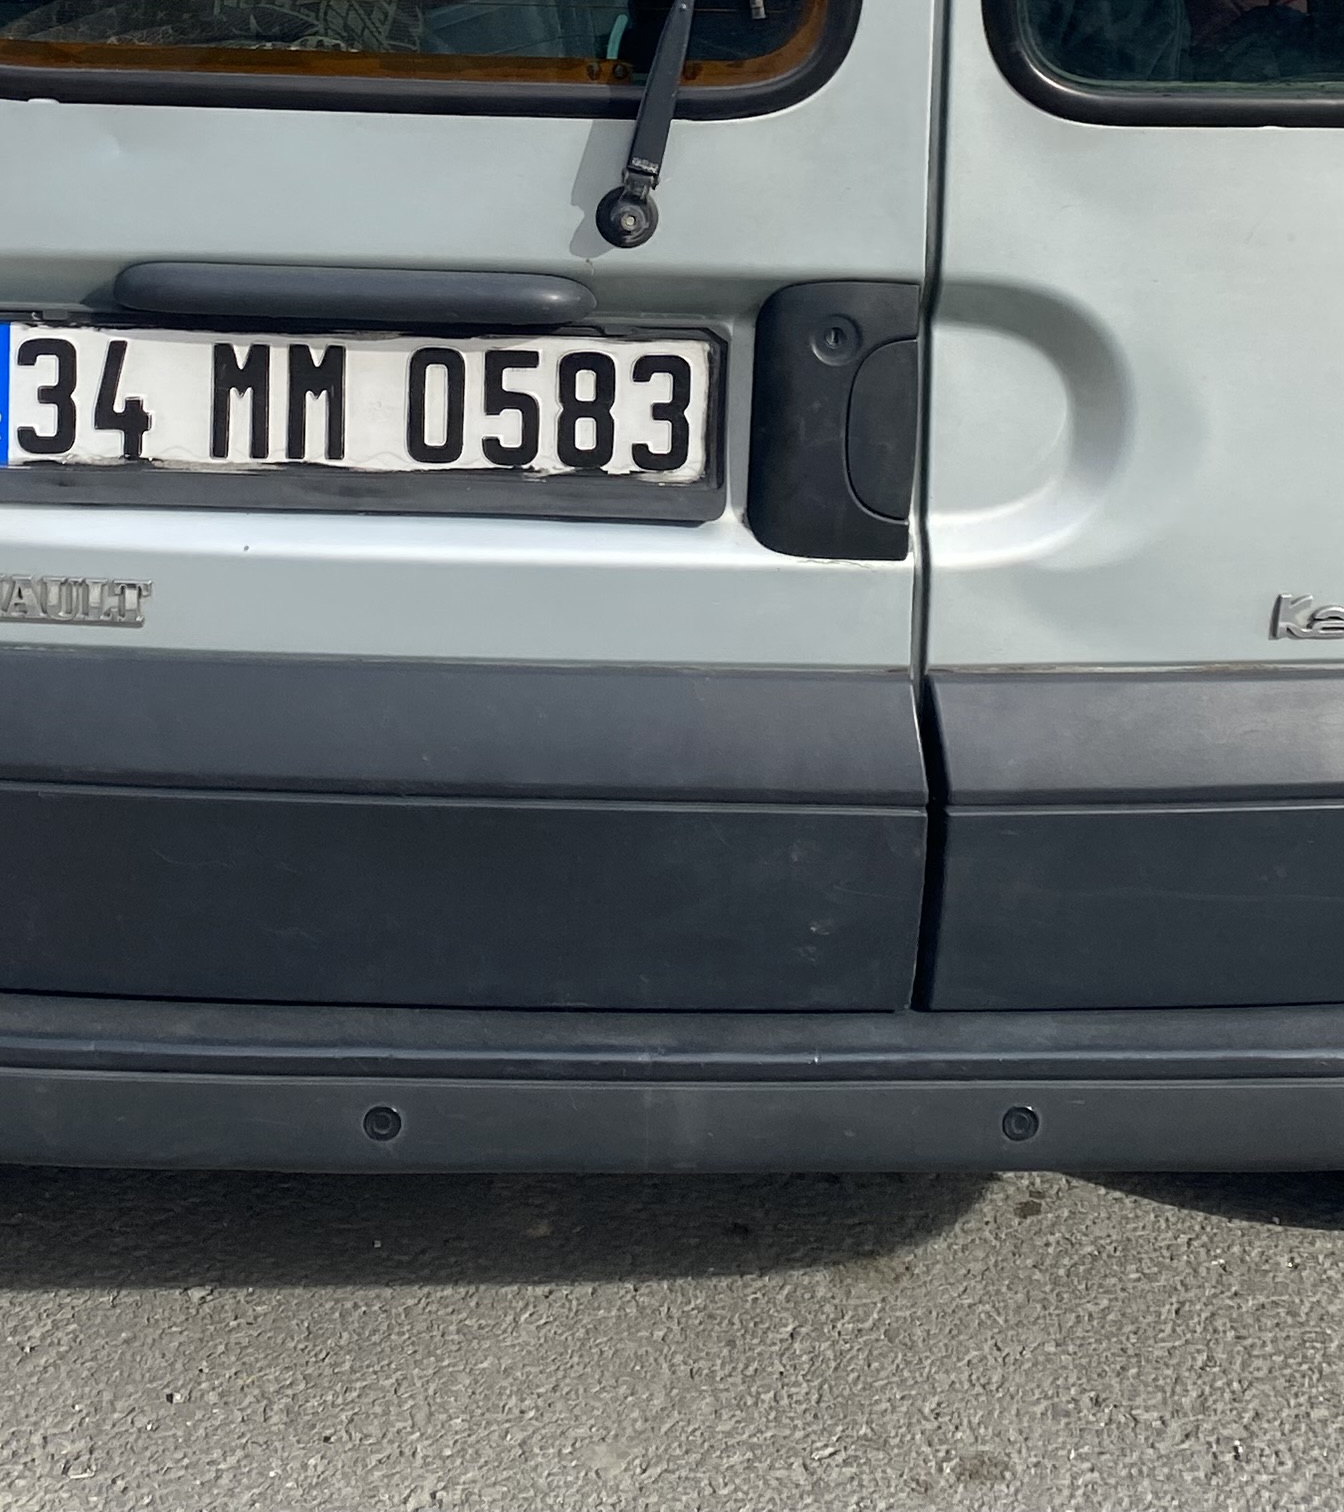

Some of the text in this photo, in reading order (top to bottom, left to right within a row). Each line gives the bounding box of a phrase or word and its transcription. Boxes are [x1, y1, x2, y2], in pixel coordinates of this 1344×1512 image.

[16, 337, 692, 472] 34 MM 0583
